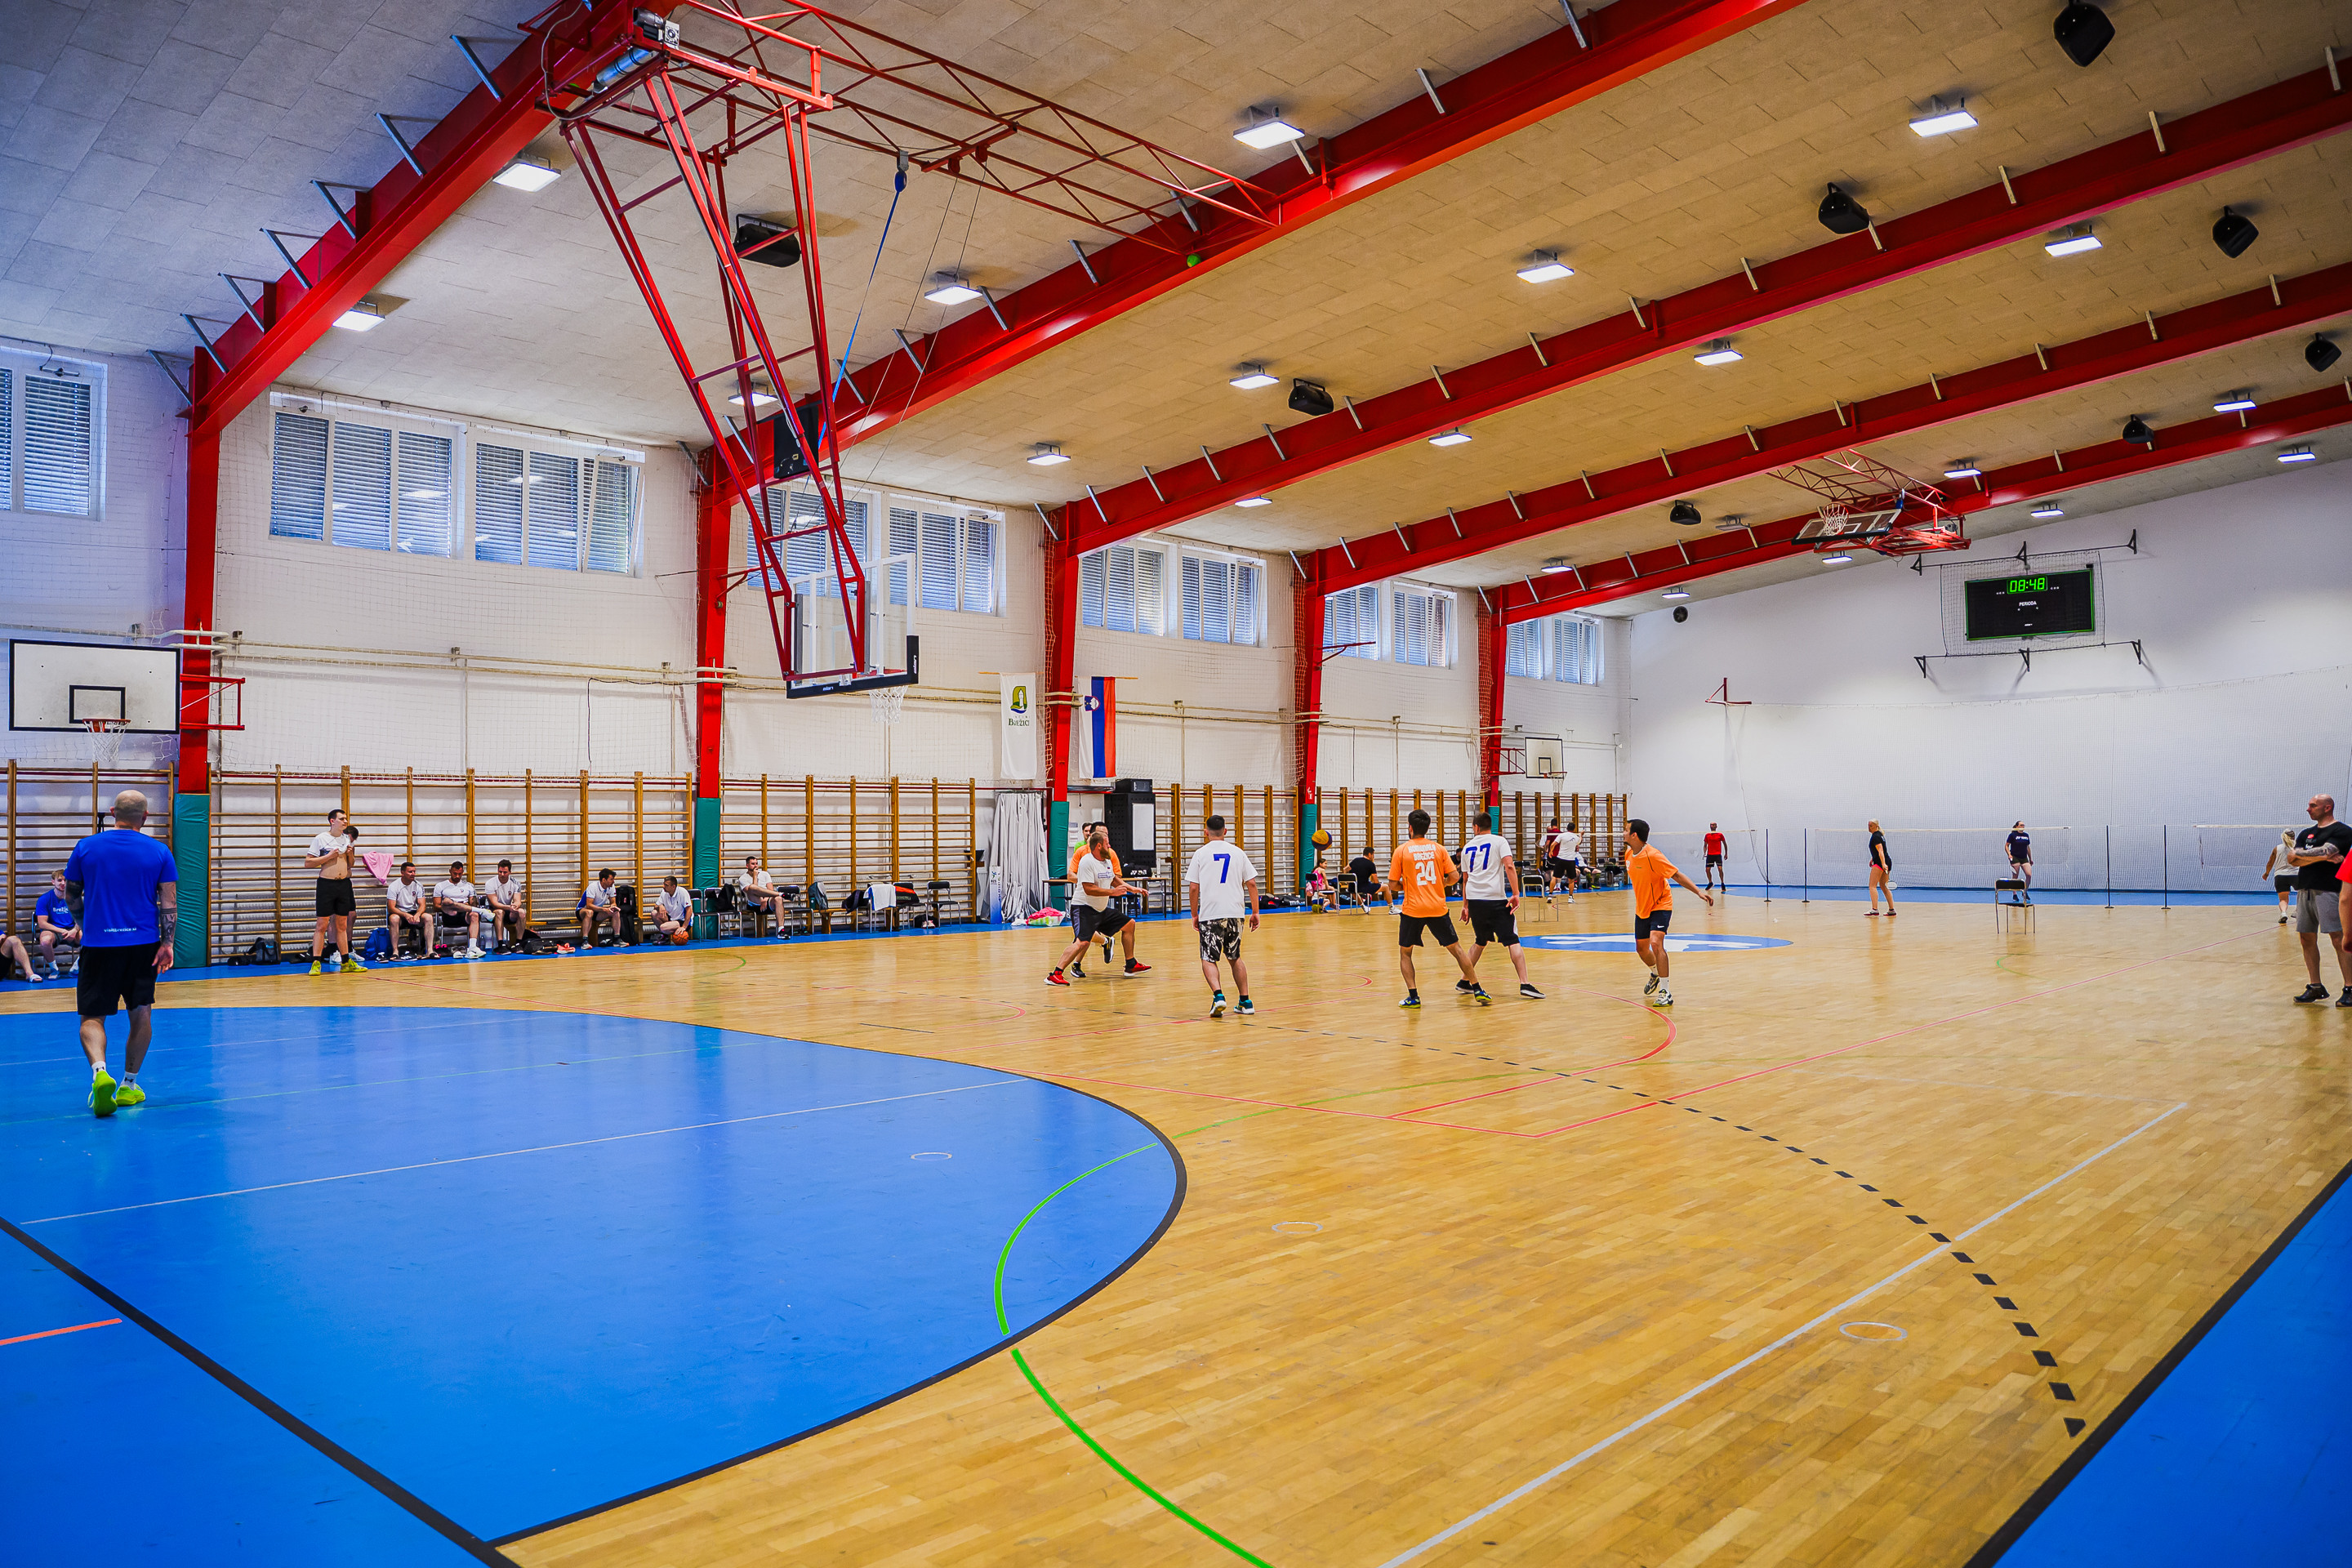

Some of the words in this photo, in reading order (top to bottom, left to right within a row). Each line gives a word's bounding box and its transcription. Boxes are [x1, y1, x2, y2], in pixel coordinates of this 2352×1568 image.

[2009, 577, 2046, 593] 08:48
[1213, 853, 1232, 884] 7
[1464, 843, 1491, 872] 77
[1414, 860, 1437, 886] 24
